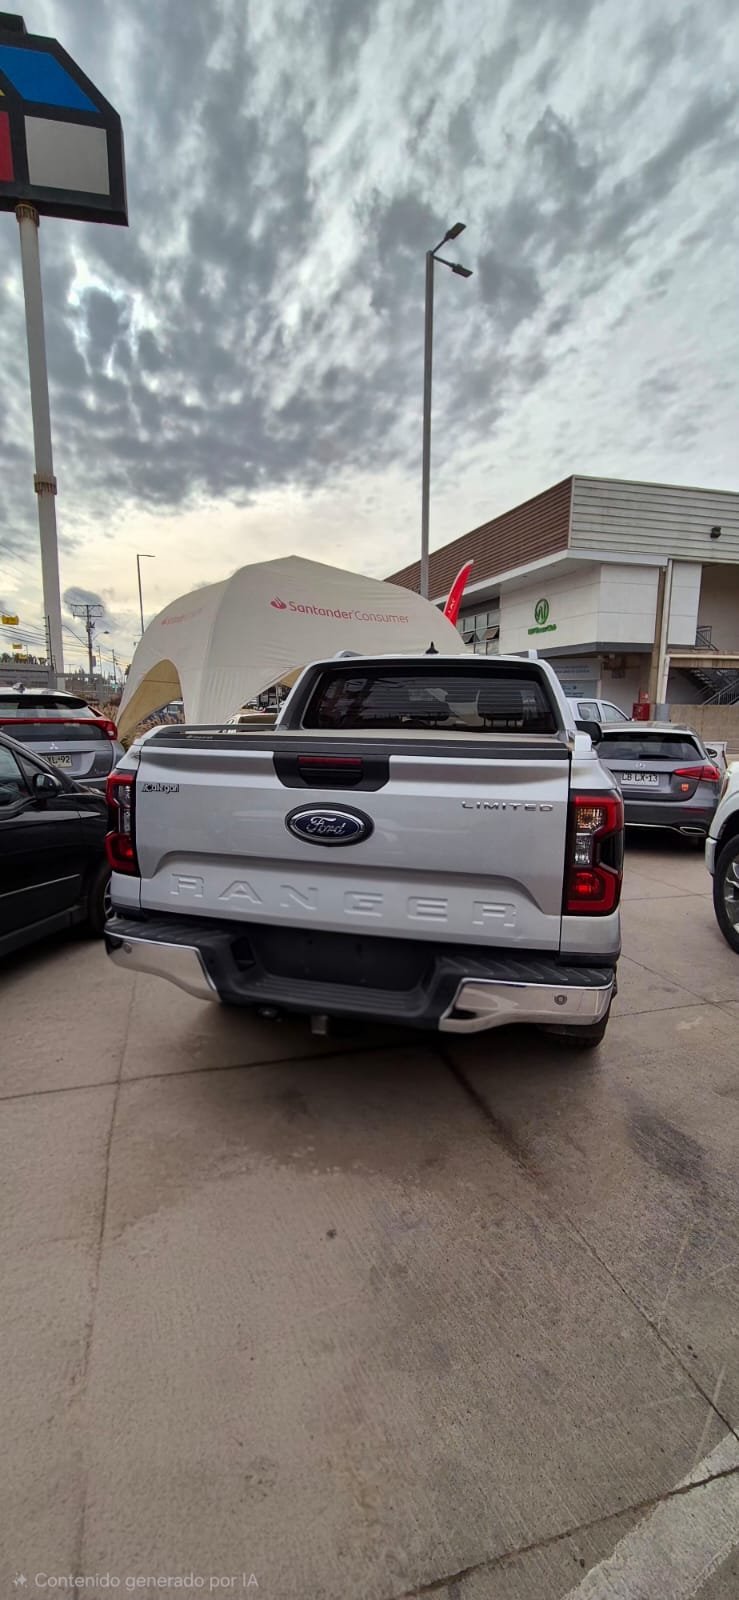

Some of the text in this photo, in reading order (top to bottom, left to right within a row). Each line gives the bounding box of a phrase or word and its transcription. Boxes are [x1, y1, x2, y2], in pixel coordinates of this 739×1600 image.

[288, 600, 409, 624] Santander Consumer
[461, 800, 554, 813] LIMITED
[306, 816, 347, 835] Ford
[168, 873, 517, 928] RANGER
